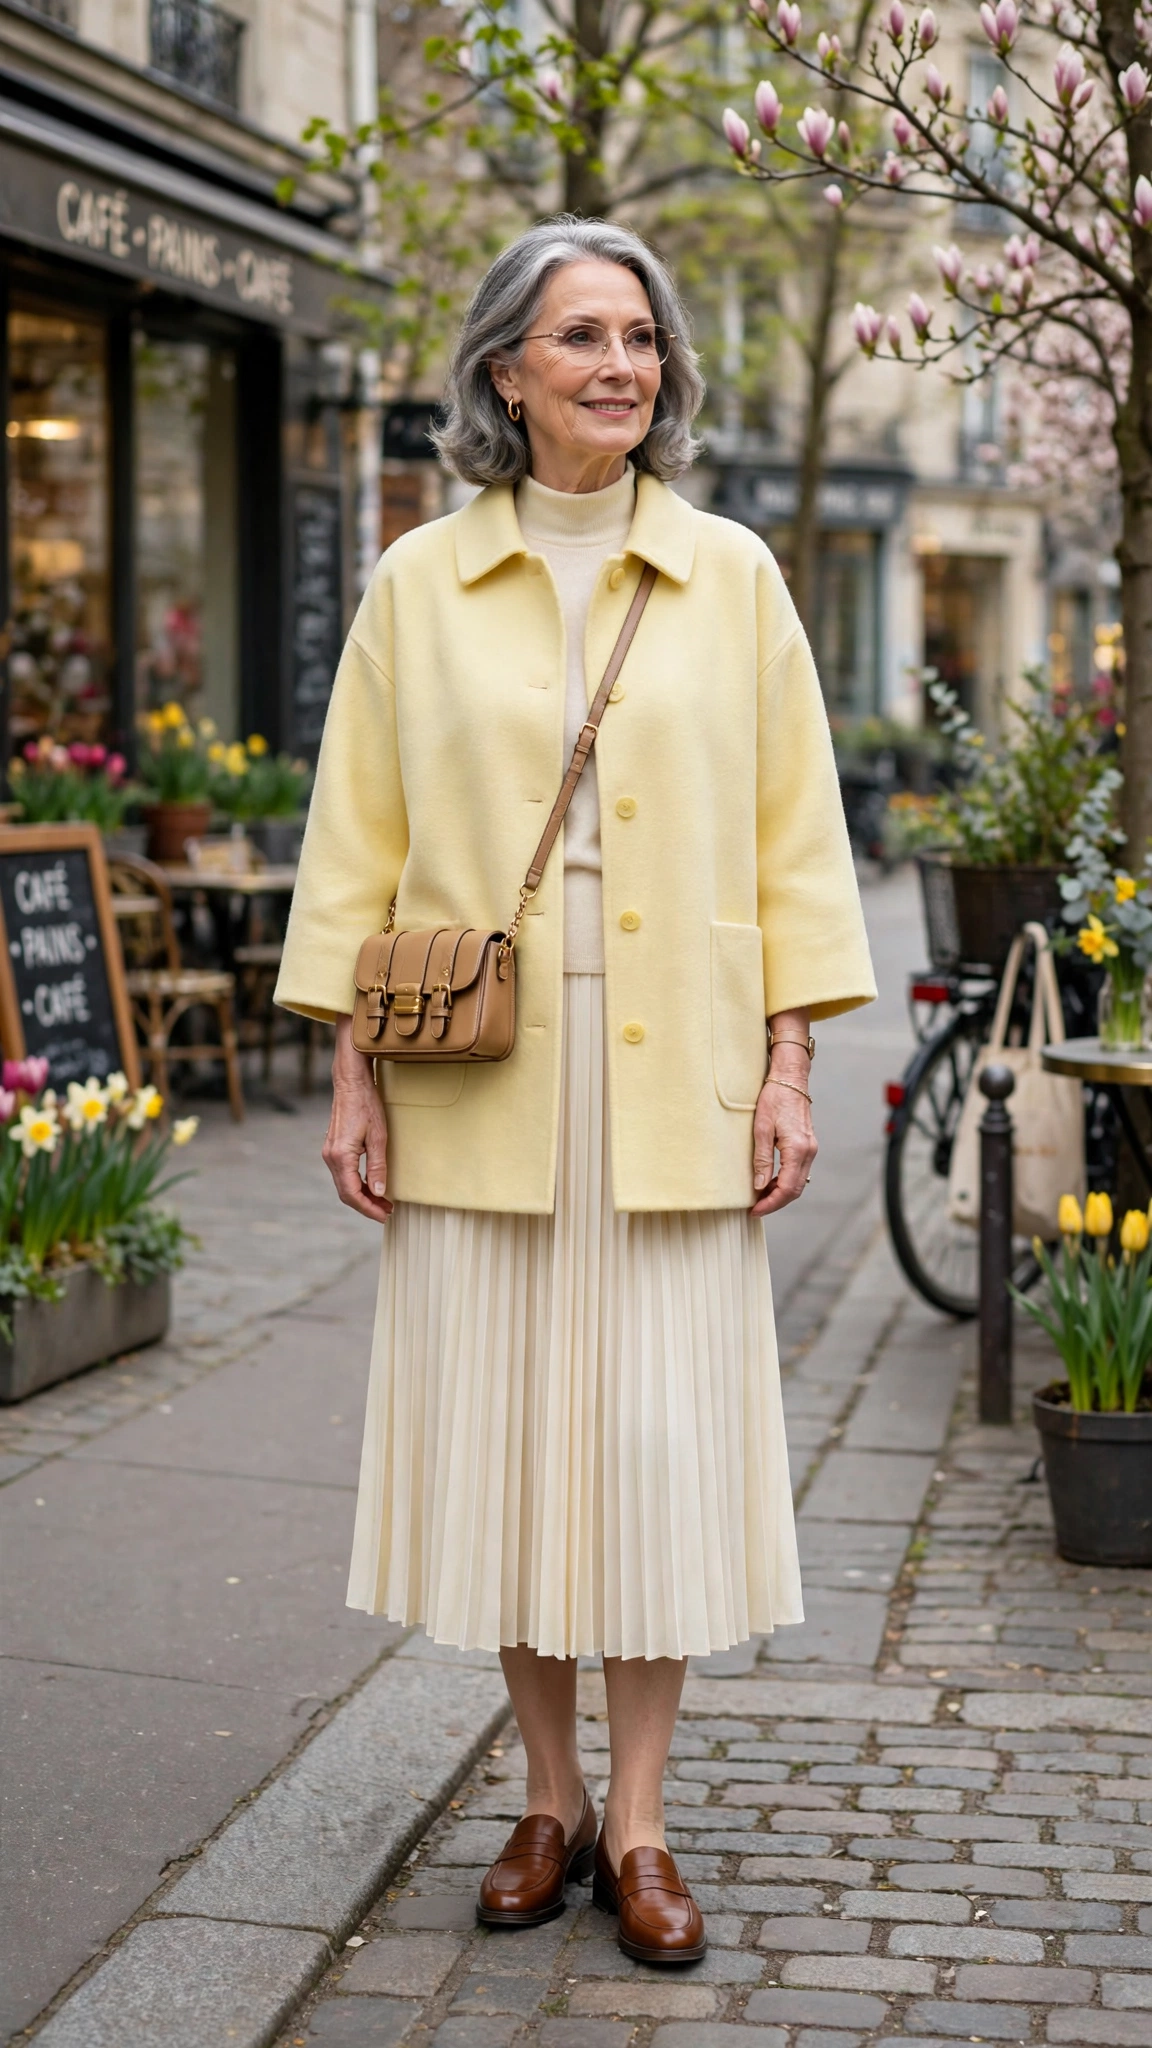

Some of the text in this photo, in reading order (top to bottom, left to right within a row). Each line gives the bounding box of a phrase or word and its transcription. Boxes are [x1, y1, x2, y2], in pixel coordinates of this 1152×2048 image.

[57, 182, 130, 257] CAFÉ
[148, 217, 221, 288] PAINS
[15, 861, 72, 914] CAFÉ
[21, 922, 85, 968] PAINS
[34, 973, 91, 1027] CAFÉ
